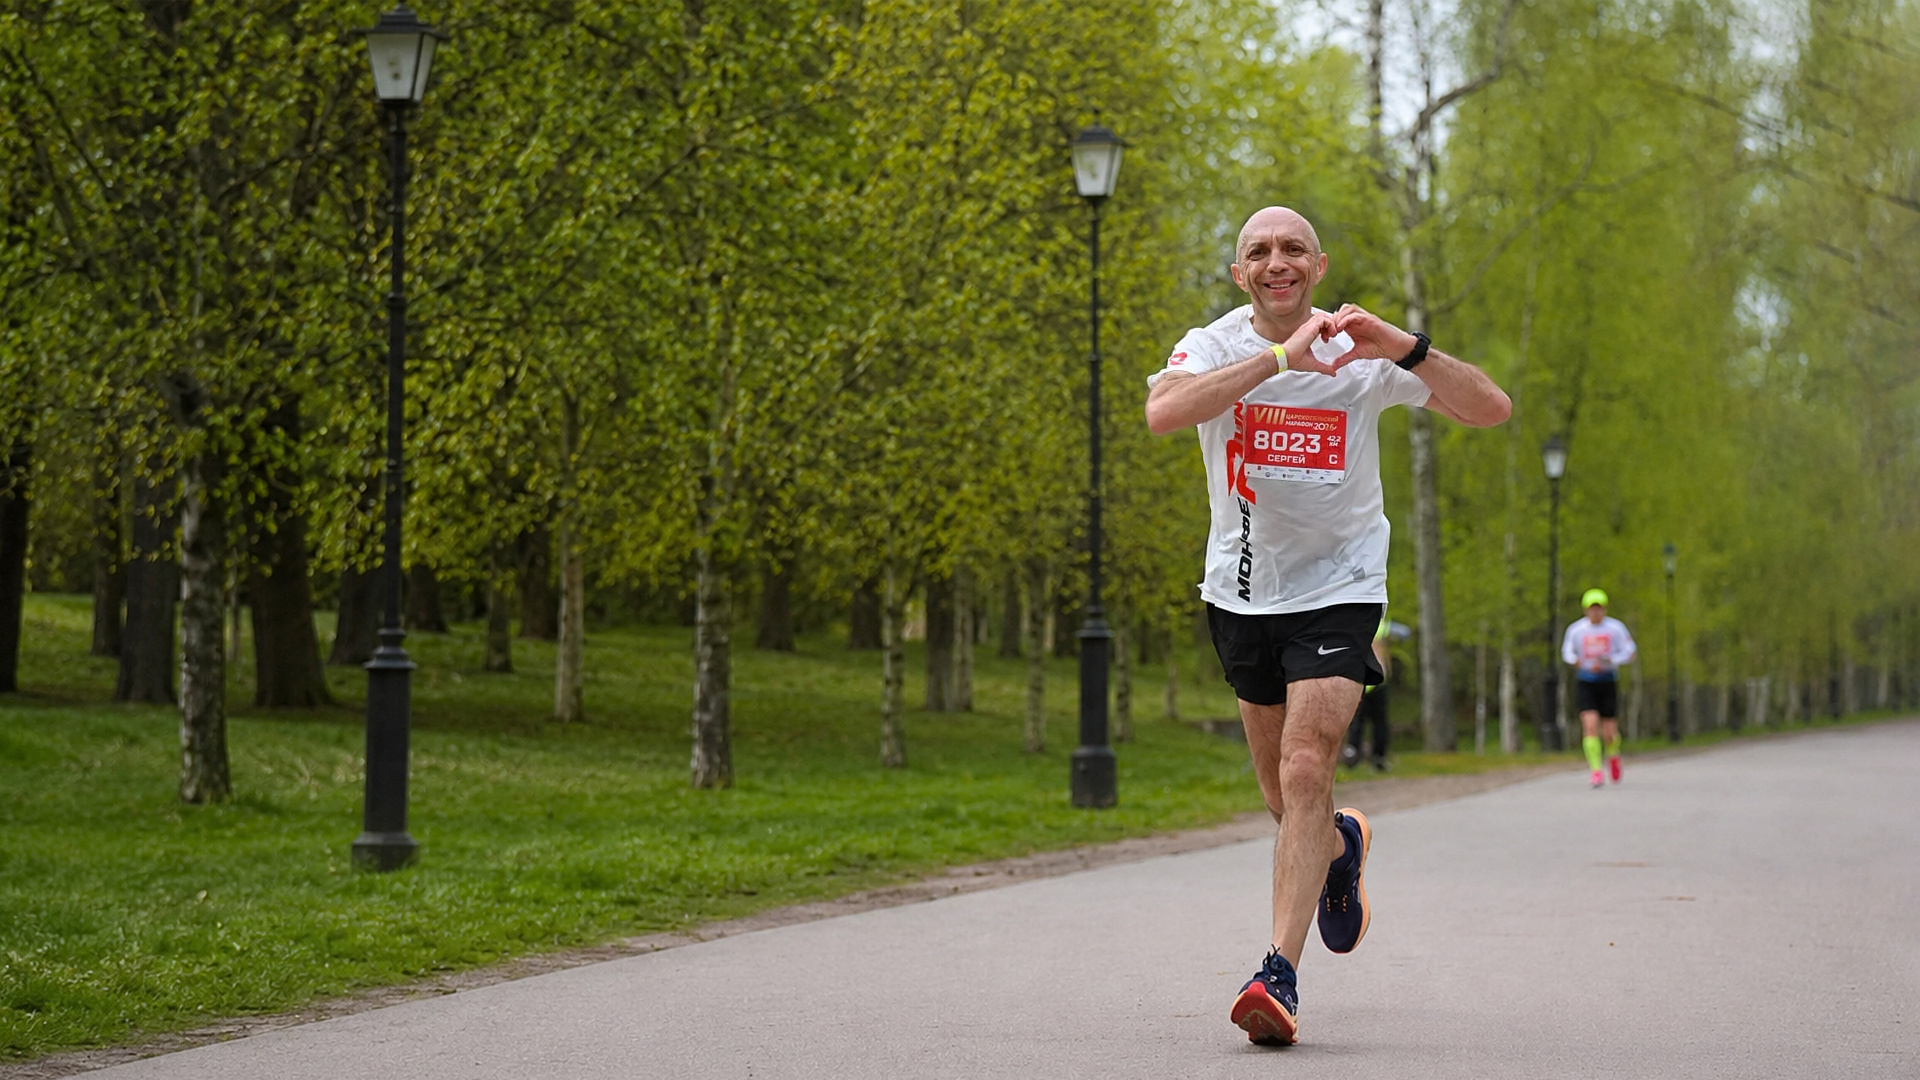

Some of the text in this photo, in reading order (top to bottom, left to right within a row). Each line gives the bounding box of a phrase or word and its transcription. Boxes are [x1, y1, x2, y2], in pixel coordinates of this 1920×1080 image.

[1253, 406, 1287, 424] VIII
[1285, 420, 1314, 428] МАРАФОН
[1253, 430, 1321, 454] 8023
[1267, 453, 1306, 464] СЕРГЕЙ
